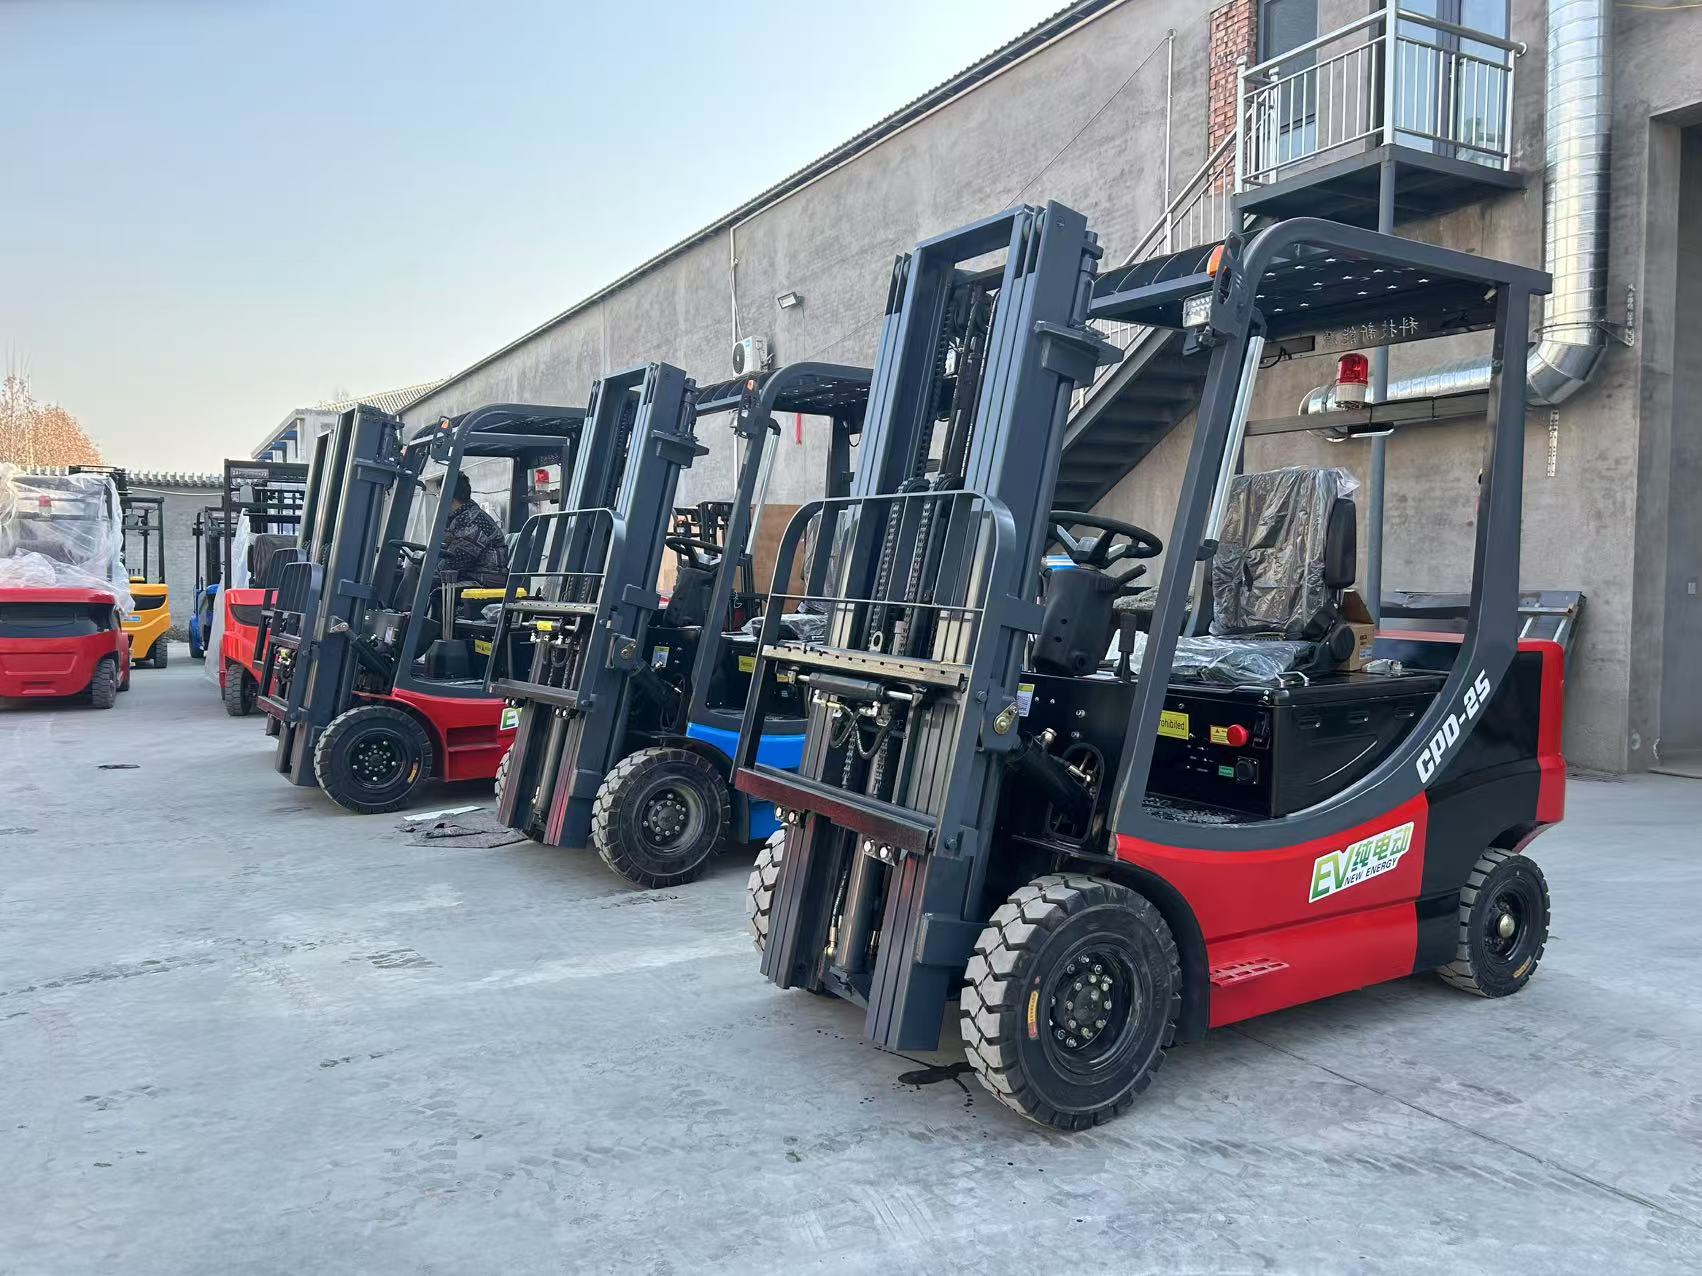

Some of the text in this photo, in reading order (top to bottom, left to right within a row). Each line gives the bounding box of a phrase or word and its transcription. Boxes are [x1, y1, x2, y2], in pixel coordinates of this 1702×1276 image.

[1416, 669, 1490, 784] CPD-25
[1311, 846, 1355, 899] EV
[1344, 857, 1397, 886] NEW ENERGY
[1351, 826, 1411, 872] 纯电动
